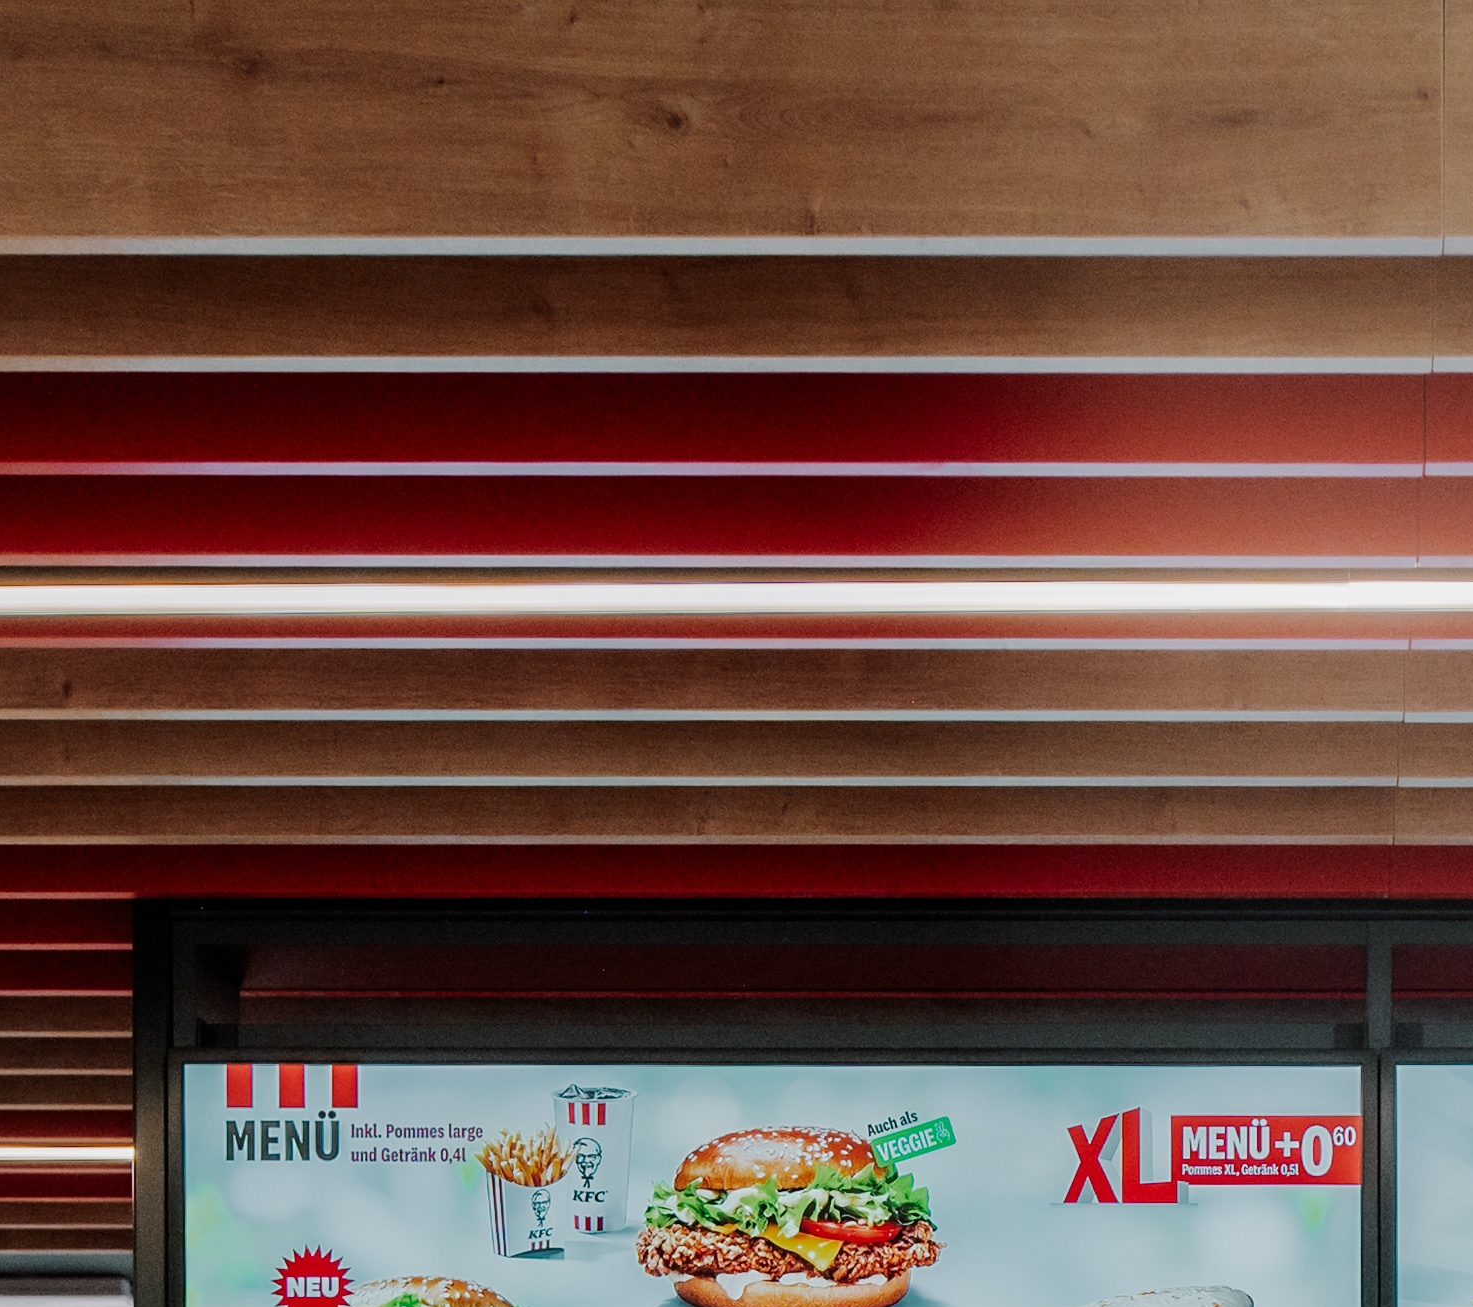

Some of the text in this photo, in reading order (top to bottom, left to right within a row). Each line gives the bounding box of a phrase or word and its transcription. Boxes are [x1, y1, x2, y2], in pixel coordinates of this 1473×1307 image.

[350, 1122, 484, 1142] Inkl. Pommes large
[866, 1110, 918, 1137] Auch als
[225, 1110, 340, 1162] MENÜ
[876, 1129, 938, 1165] VEGGIE
[1181, 1119, 1270, 1160] MENÜ
[350, 1146, 467, 1165] und Getränk 0,4l
[1064, 1107, 1178, 1203] XL
[1181, 1163, 1299, 1178] Pommes XL, Getränk 0,5l
[573, 1190, 608, 1203] KFC
[285, 1276, 339, 1298] NEU
